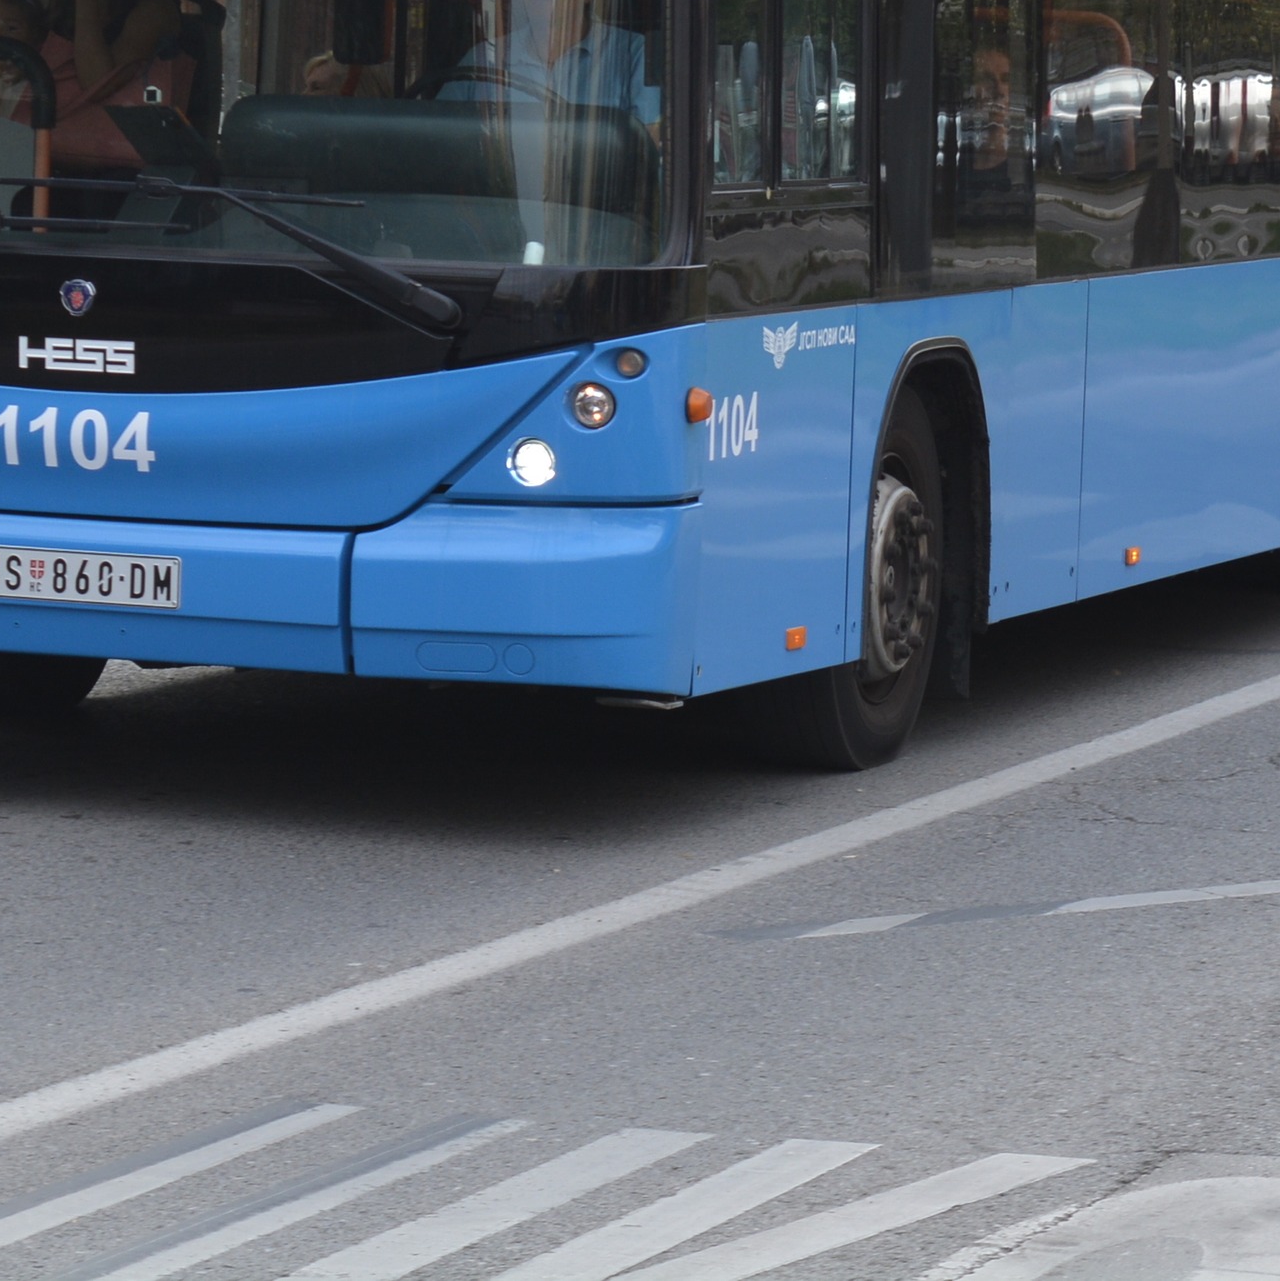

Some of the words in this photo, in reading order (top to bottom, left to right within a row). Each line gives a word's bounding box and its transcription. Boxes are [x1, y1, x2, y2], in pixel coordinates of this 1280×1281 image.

[18, 335, 136, 375] HESS
[817, 327, 838, 348] НОВИ
[838, 325, 856, 345] САД
[705, 391, 759, 461] 1104
